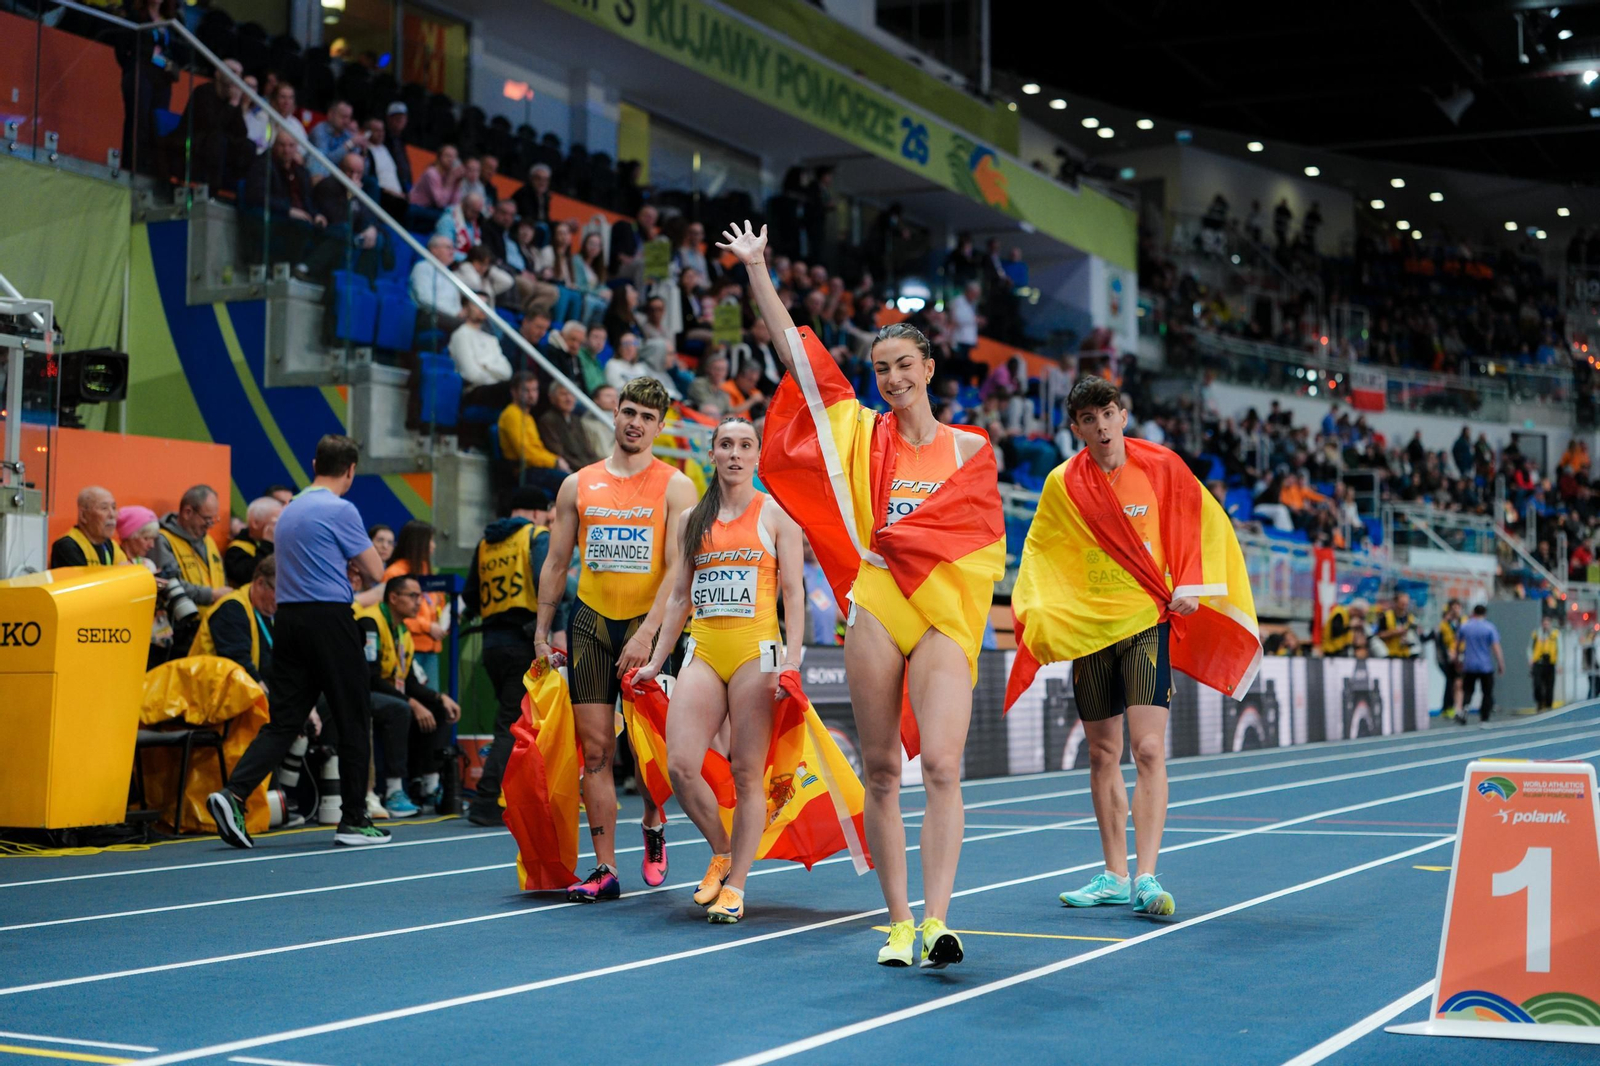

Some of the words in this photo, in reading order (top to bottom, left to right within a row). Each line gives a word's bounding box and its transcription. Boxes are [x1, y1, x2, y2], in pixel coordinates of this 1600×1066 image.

[646, 0, 771, 89] KUJAWY
[775, 52, 897, 150] POMORZE
[584, 505, 655, 519] ESPAÑA
[603, 527, 648, 542] TDK
[587, 544, 650, 560] FERNANDEZ
[697, 570, 750, 584] SONY
[1087, 569, 1133, 583] GARC
[480, 571, 523, 608] 035
[693, 587, 751, 605] SEVILLA
[77, 628, 132, 644] SEIKO
[769, 644, 778, 668] 1
[806, 667, 847, 684] SONY
[1522, 780, 1547, 788] WORLD
[1548, 781, 1585, 789] ATHLETICS
[1491, 846, 1552, 974] 1
